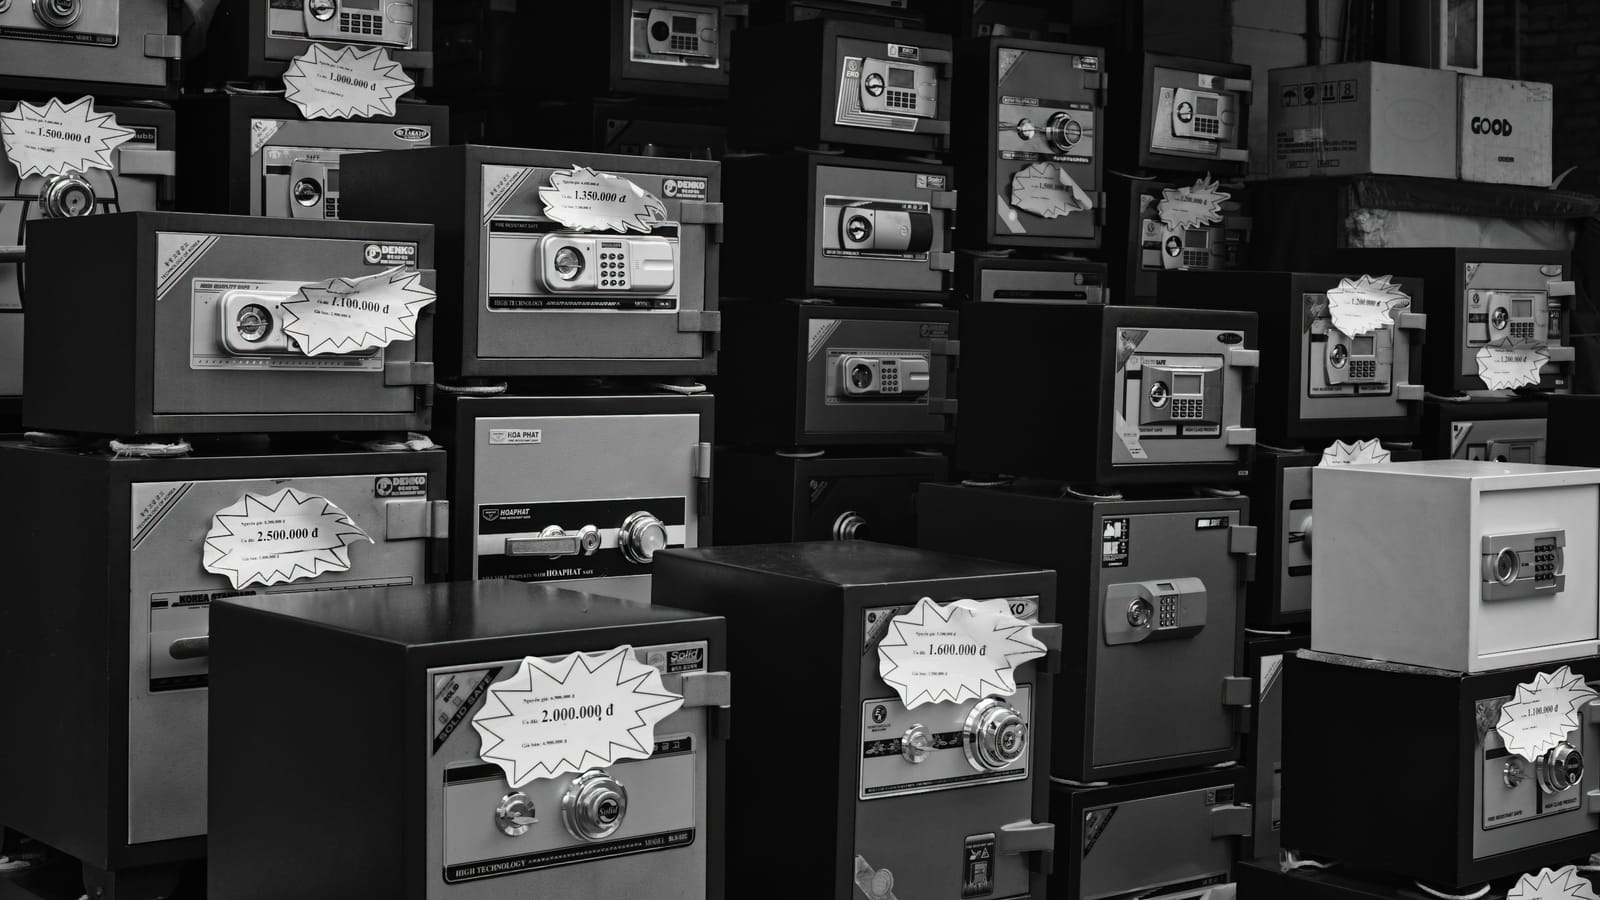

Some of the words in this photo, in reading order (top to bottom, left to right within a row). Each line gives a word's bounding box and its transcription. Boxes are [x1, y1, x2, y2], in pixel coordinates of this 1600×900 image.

[330, 72, 368, 88] 1.000.000
[1471, 116, 1512, 136] GOOD
[38, 128, 81, 142] 1.500.000
[677, 180, 705, 190] DENKO
[575, 190, 617, 203] 1.350.000
[381, 245, 415, 255] DENKO
[333, 296, 379, 313] 1.100.000
[512, 300, 543, 308] TECHNOLOGY
[508, 431, 521, 439] HOA
[392, 476, 426, 486] DENKO
[500, 508, 531, 516] HOAPHAT
[257, 529, 308, 542] 2.500.000
[546, 568, 581, 577] HOAPHAT
[179, 593, 210, 604] KOREA
[1008, 603, 1024, 615] KO
[670, 648, 700, 661] Solid
[929, 644, 977, 656] 1.600.000
[979, 644, 986, 656] đ
[443, 683, 460, 703] SOLID
[438, 705, 469, 742] SOLID
[467, 674, 492, 706] SAFE
[541, 704, 601, 722] 2.000.000
[1527, 705, 1554, 717] 1.100.000
[599, 806, 618, 815] Solid
[455, 863, 476, 877] HIGH
[477, 858, 526, 874] TECHNOLOGY
